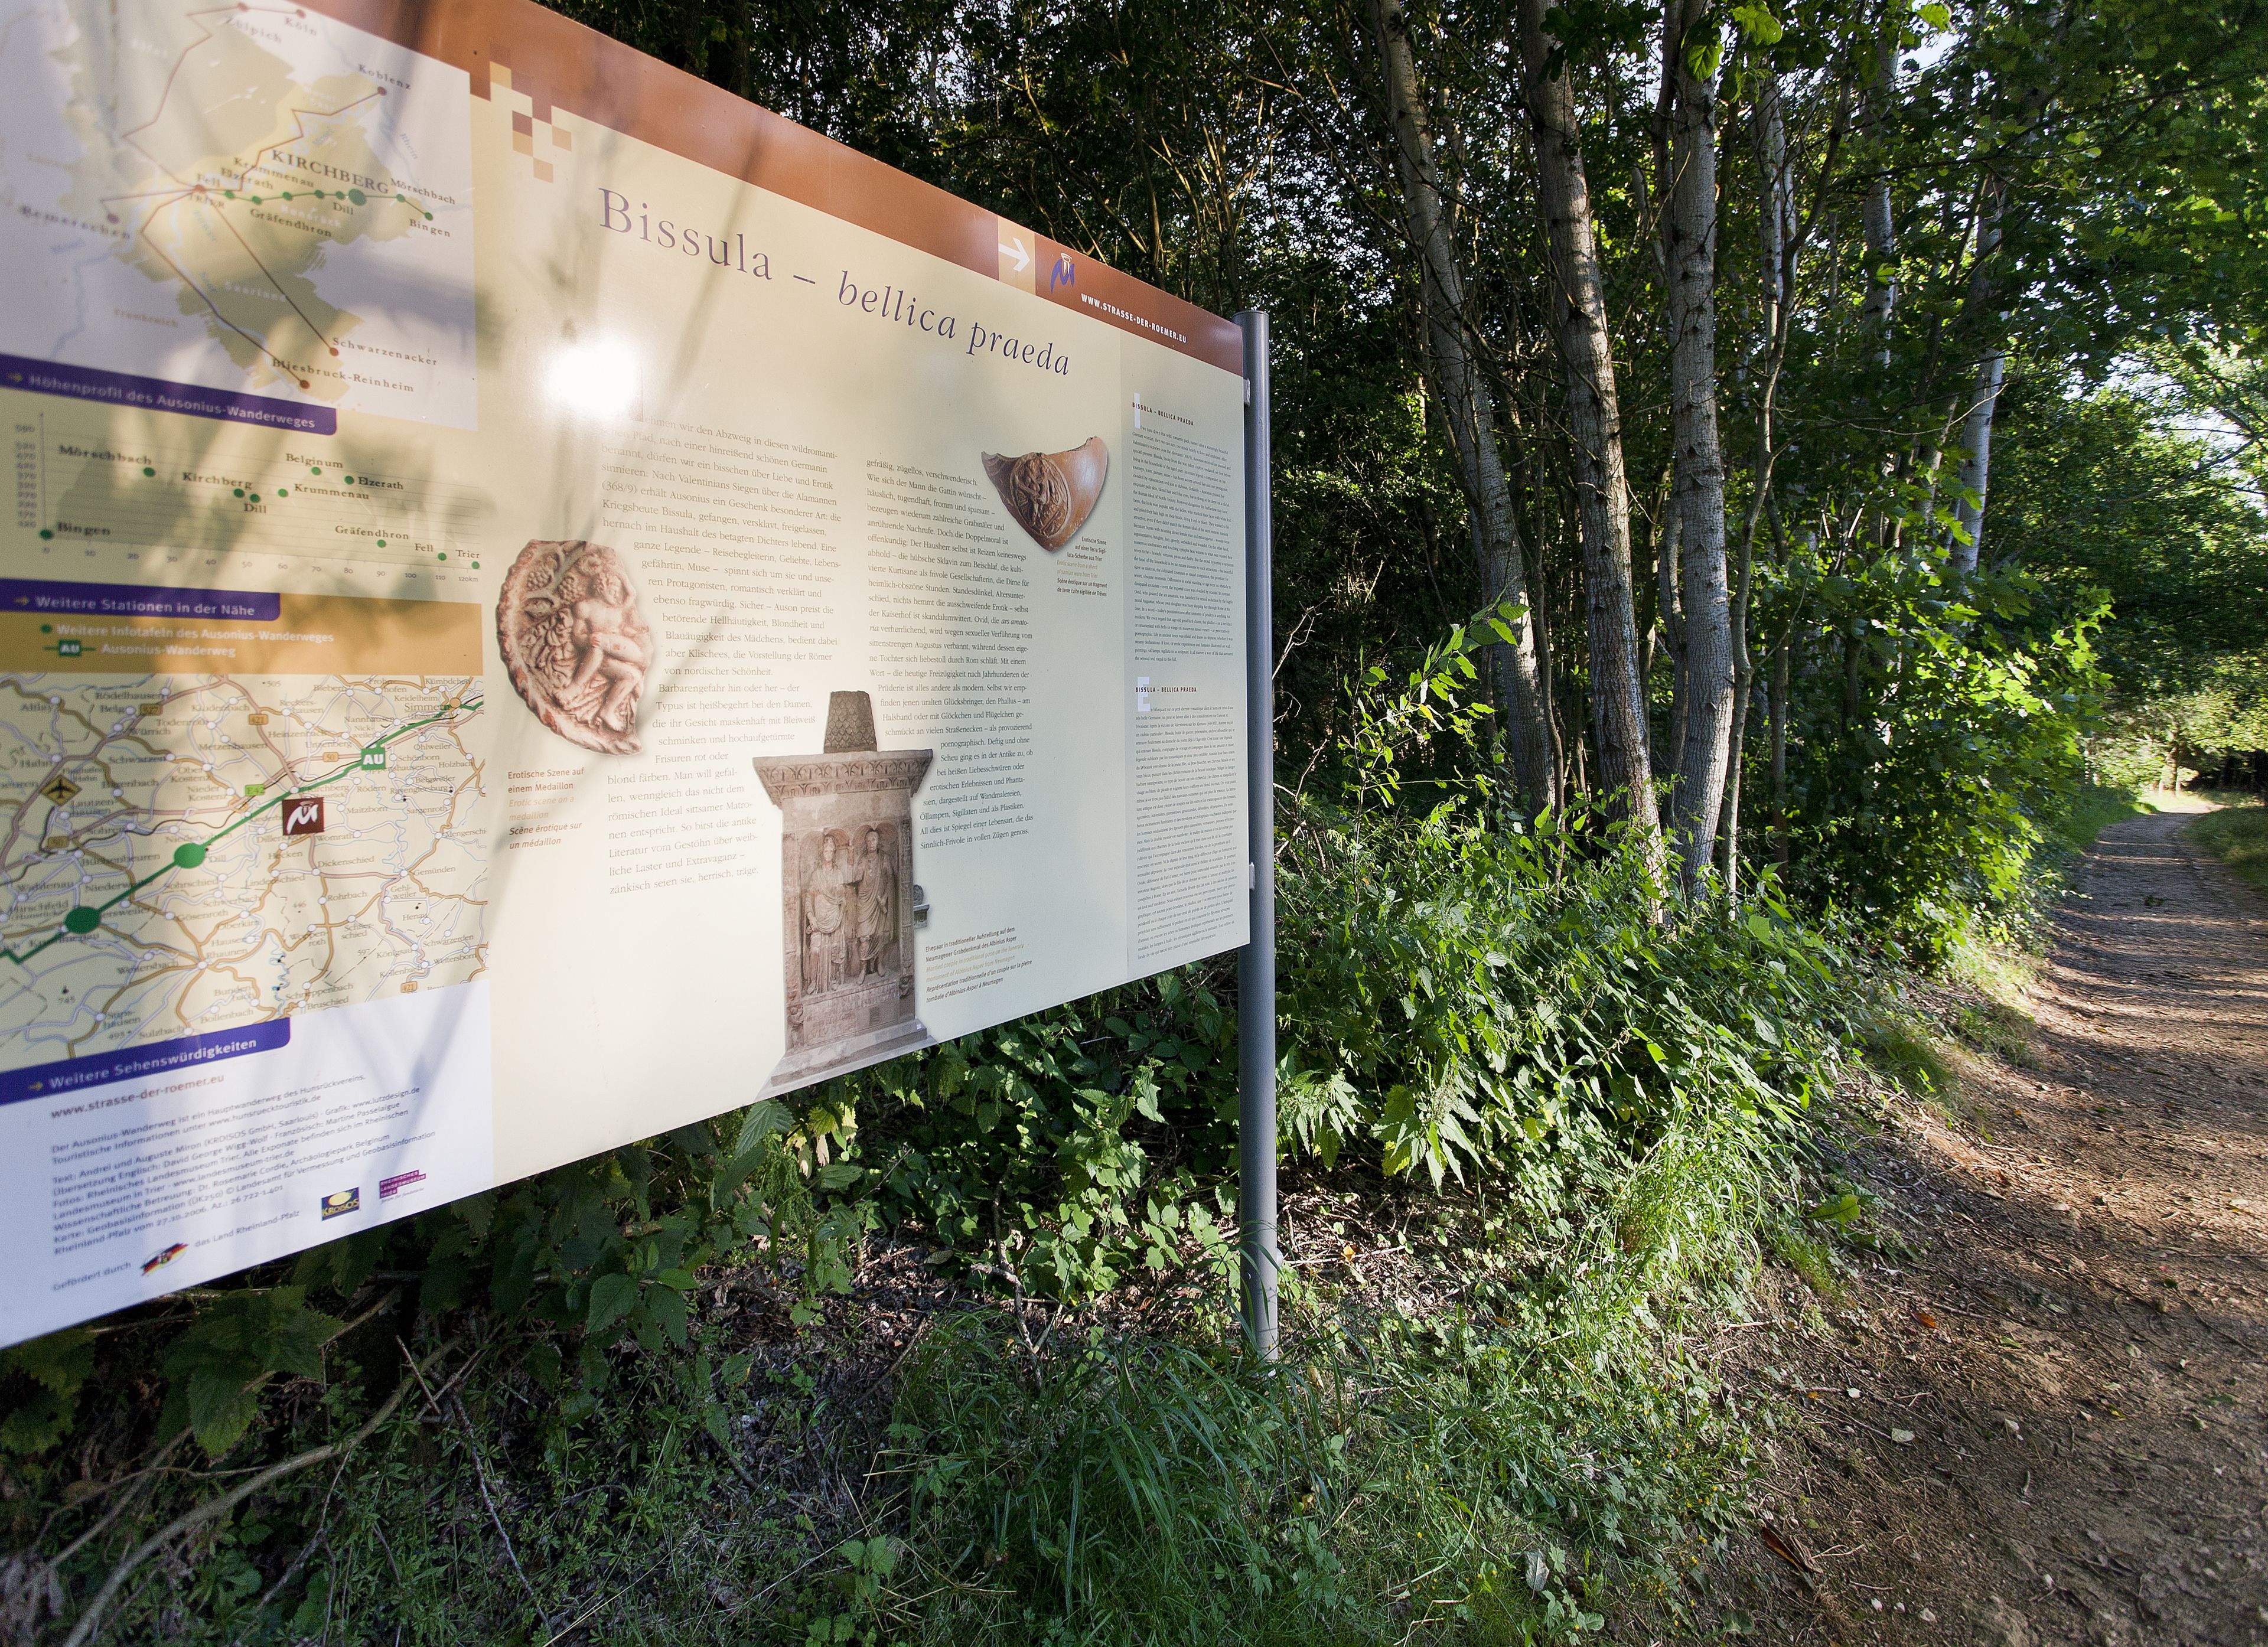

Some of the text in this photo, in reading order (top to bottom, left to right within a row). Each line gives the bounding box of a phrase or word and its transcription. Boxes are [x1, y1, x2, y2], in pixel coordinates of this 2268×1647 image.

[284, 17, 317, 36] Köln
[357, 64, 411, 90] Koblenz
[271, 149, 389, 194] KIRCHBERG
[390, 178, 455, 204] Mörschbach
[333, 202, 354, 215] Dill
[250, 208, 332, 237] Gräfendhron
[409, 219, 451, 237] Bingen
[598, 188, 773, 281] Bissula
[838, 270, 956, 339] bellica
[966, 321, 1070, 376] praeda
[1081, 293, 1187, 343] WWW.STRASSE-DER-ROEMER.EU
[332, 337, 438, 366] Schwarzenacker
[272, 358, 414, 392] Bliesbruck-Reinheim
[28, 374, 315, 429] Höhenprofil des Ausonius-Wanderweges
[1132, 402, 1194, 426] BISSULA BELLICA PRAEDA
[58, 445, 152, 465] Mörschbach
[286, 454, 343, 468] Belginum
[183, 472, 253, 491] Kirchberg
[866, 459, 977, 486] gefräßig, zügellos, verschwenderisch.
[294, 483, 369, 500] Krummenau
[358, 477, 403, 490] Elzerath
[601, 464, 837, 506] sinnieren: Nach Valentinians Siegen über die Alamannen
[244, 504, 267, 514] Dill
[602, 481, 841, 522] (368/9) erhält Ausonius ein Geschenk besonderer Art: die
[58, 522, 110, 536] Bingen
[335, 526, 409, 540] Gräfendhron
[603, 518, 836, 552] hernach im Haushalt des betagten Dichters lebend. Eine
[415, 543, 433, 552] Fell
[455, 549, 480, 559] Trier
[35, 595, 255, 616] Weitere Stationen in der Nähe
[56, 625, 107, 637] Weitere
[177, 628, 198, 639] des
[201, 629, 334, 644] Ausonius-Wanderweges
[101, 644, 236, 658] Ausonius-Wanderweg
[905, 670, 927, 679] heutige
[929, 670, 966, 679] Freizügigkeit
[998, 723, 1032, 733] provozierend
[363, 755, 384, 765] AU
[508, 767, 584, 779] Erotische Szene auf
[508, 782, 573, 793] einem Medaillon
[347, 806, 387, 814] Maitzborn
[406, 806, 448, 814] Sargenroth
[509, 797, 532, 807] Erotic
[534, 797, 556, 805] scene
[509, 811, 549, 821] medallion
[509, 821, 582, 836] Scène érotique sur
[509, 837, 561, 849] un médaillon
[920, 837, 964, 850] Sinnlich-Frivole
[992, 831, 1009, 841] Zügen
[1011, 829, 1029, 838] genoss.
[318, 856, 374, 867] Dickenschied
[327, 891, 367, 902] Rohrbach
[926, 944, 943, 953] Ehepaar
[49, 1039, 256, 1090] Weitere Sehenswürdigkeiten
[51, 1074, 224, 1119] www.strasse-der-roemer.eu
[322, 1198, 359, 1217] KROISOS
[213, 1229, 234, 1242] Land
[236, 1211, 300, 1235] Rheinland-Pfalz
